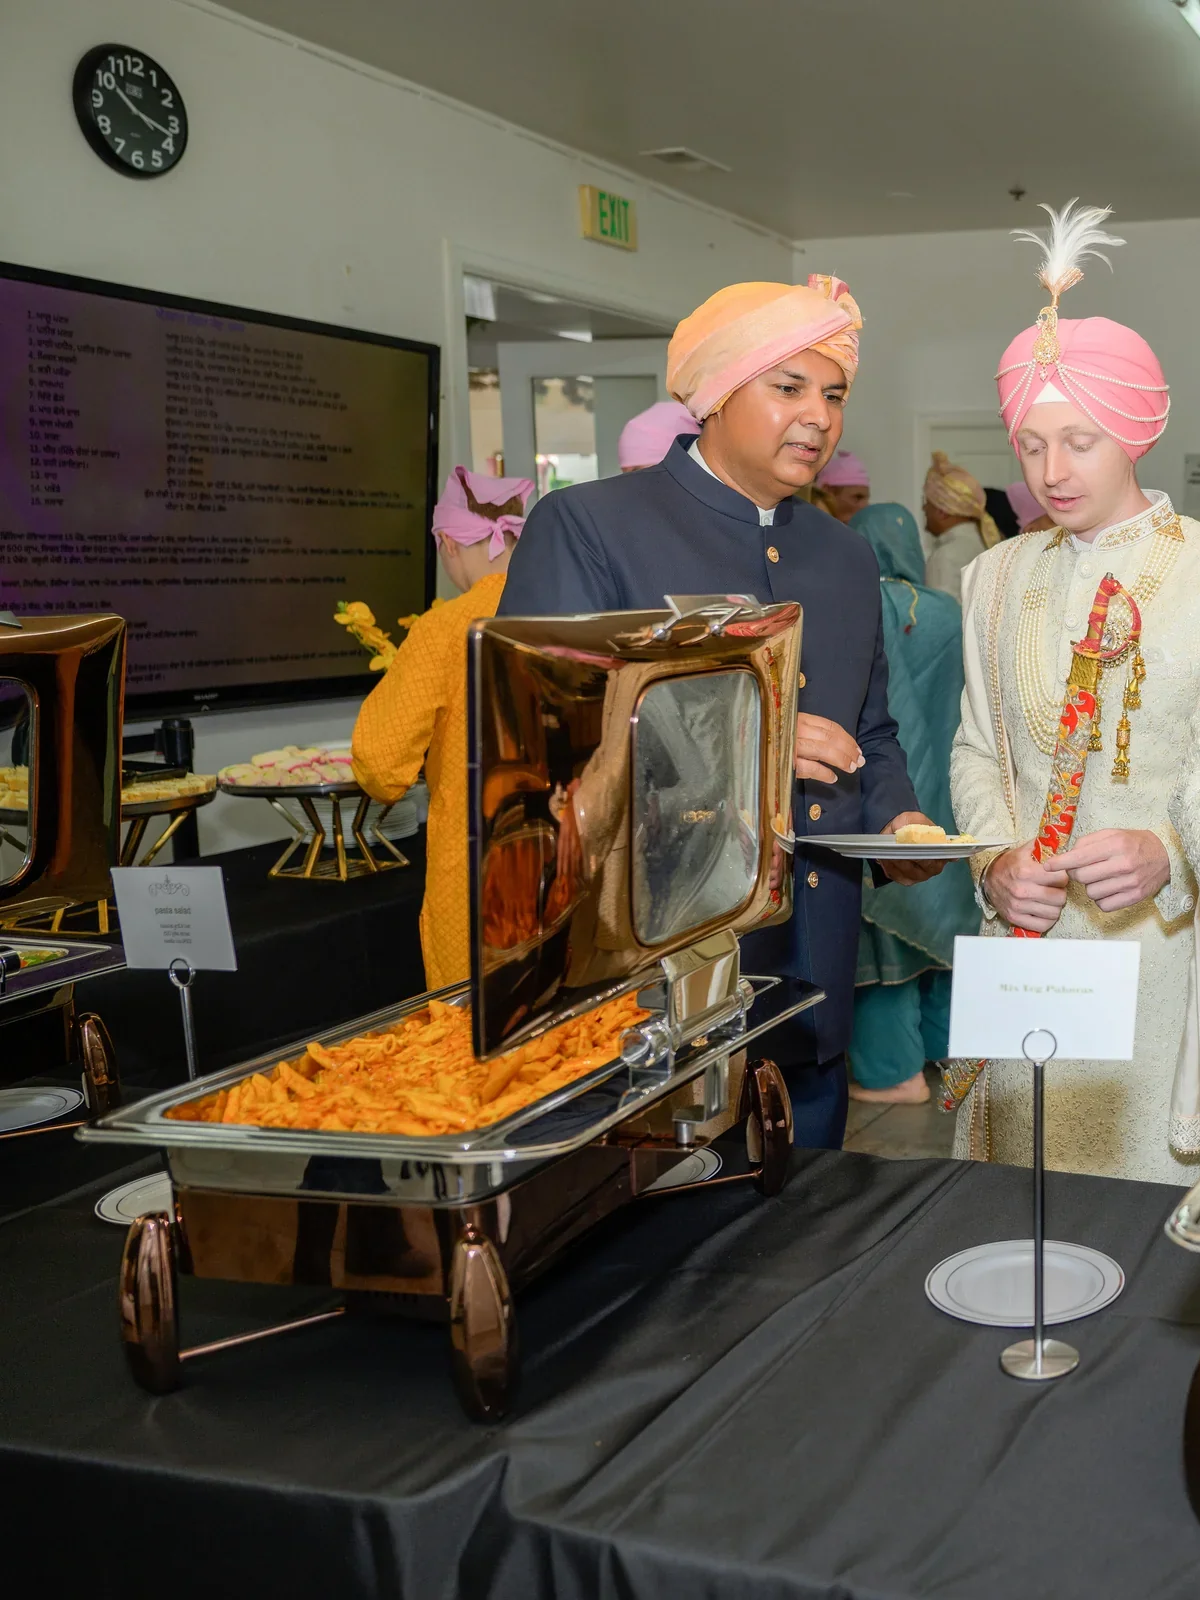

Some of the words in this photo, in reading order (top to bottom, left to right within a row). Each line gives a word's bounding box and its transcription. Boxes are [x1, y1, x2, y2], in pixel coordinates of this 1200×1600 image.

[108, 56, 123, 76] 11
[124, 55, 144, 77] 12
[96, 69, 115, 90] 10
[149, 70, 157, 88] 1
[92, 89, 104, 108] 9
[161, 88, 173, 108] 2
[97, 115, 111, 135] 8
[114, 137, 126, 154] 7
[131, 150, 144, 169] 6
[151, 149, 163, 167] 5
[598, 191, 629, 243] EXIT
